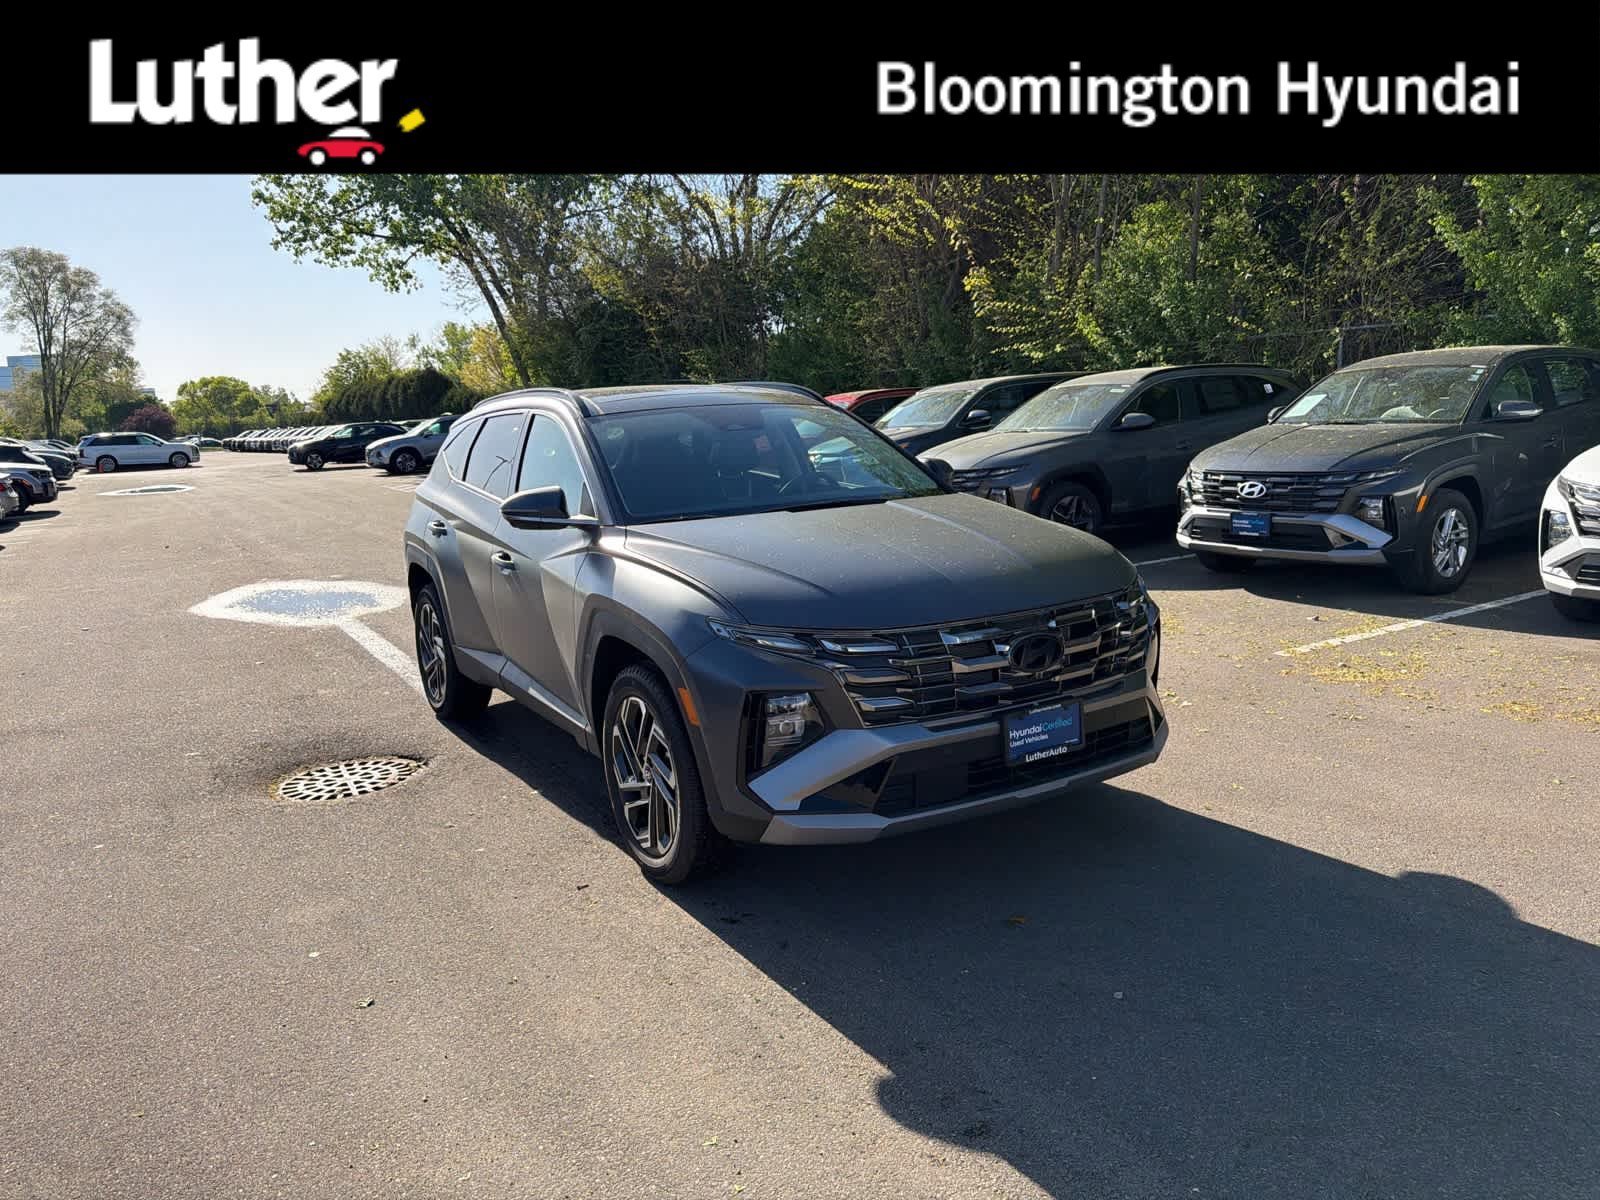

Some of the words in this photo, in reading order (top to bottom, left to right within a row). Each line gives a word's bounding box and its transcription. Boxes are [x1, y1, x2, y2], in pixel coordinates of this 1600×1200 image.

[1009, 739, 1025, 748] Used
[1024, 733, 1049, 744] Vehicles
[1025, 746, 1068, 763] LutherAuto
